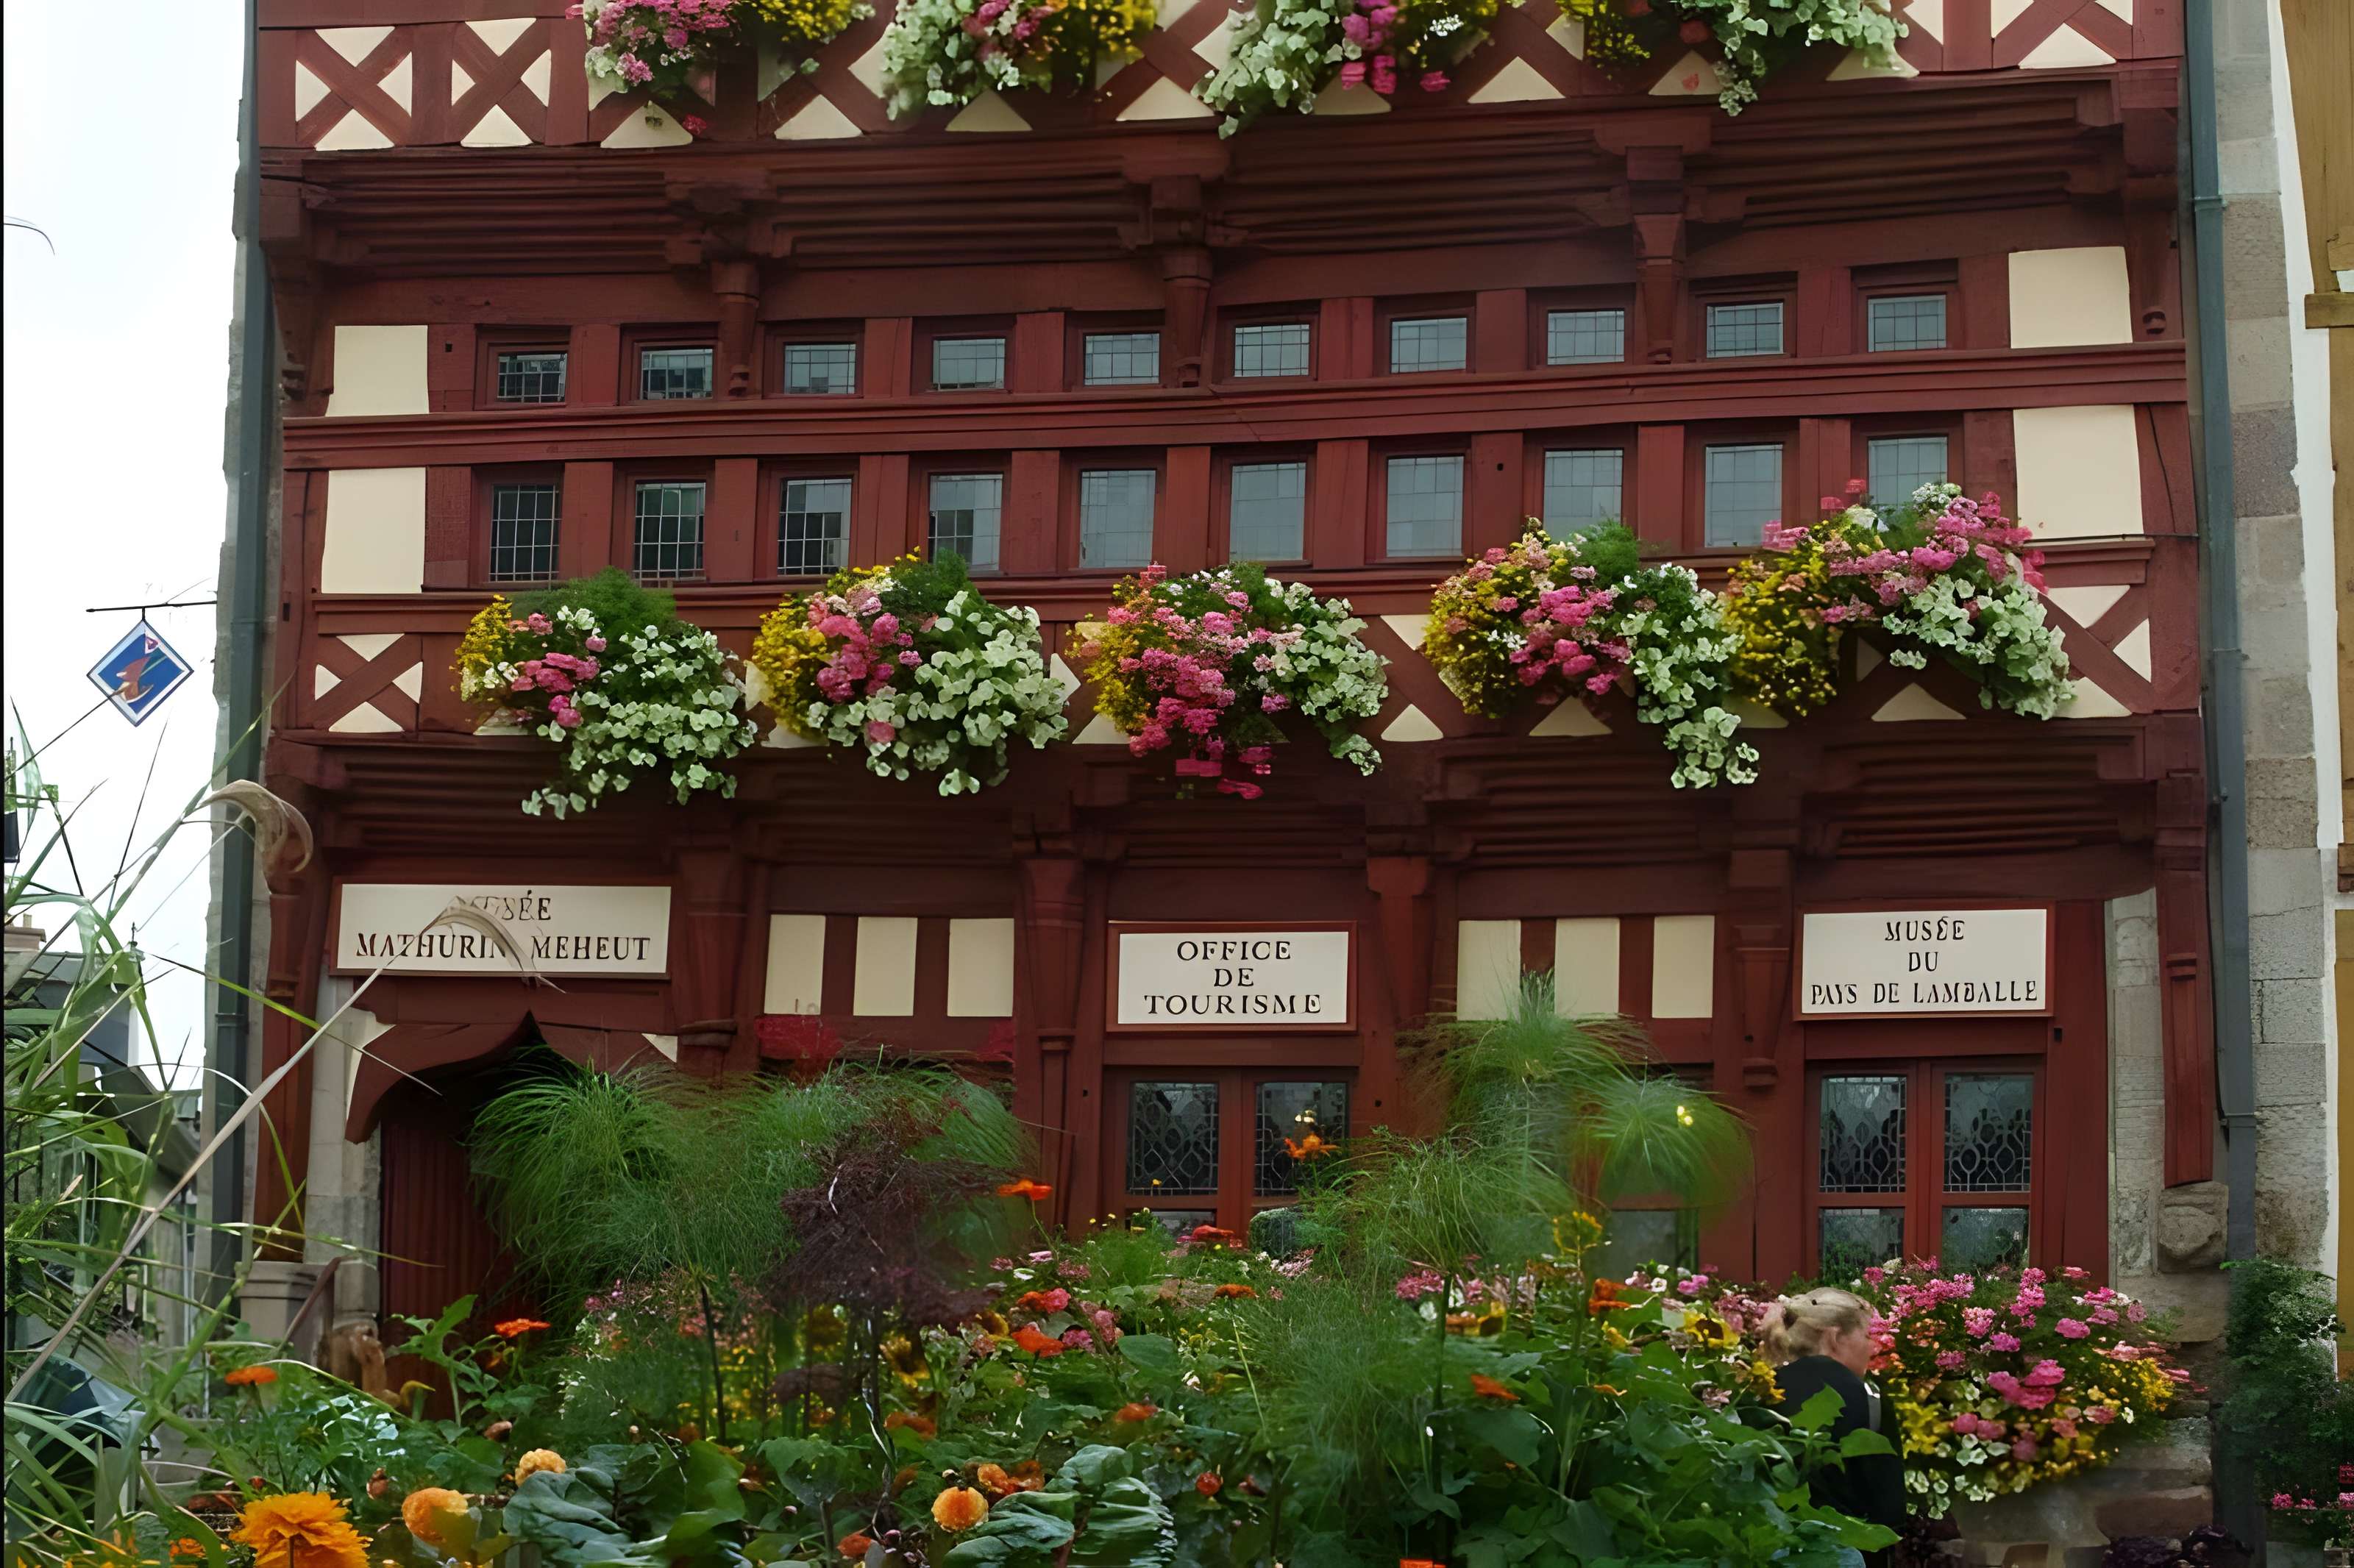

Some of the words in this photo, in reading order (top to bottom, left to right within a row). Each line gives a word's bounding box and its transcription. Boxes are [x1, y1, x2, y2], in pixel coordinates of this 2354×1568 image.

[1885, 916, 1965, 941] MUSÉE
[531, 936, 651, 961] MEHEUT
[1177, 941, 1291, 961] OFFICE
[1908, 952, 1938, 972] DU
[1214, 968, 1254, 987] DE
[1811, 984, 1857, 1005] PAYS
[1873, 983, 1900, 1003] DE
[1914, 980, 2038, 1002] LAMBALLE
[1144, 994, 1321, 1015] TOURISME
